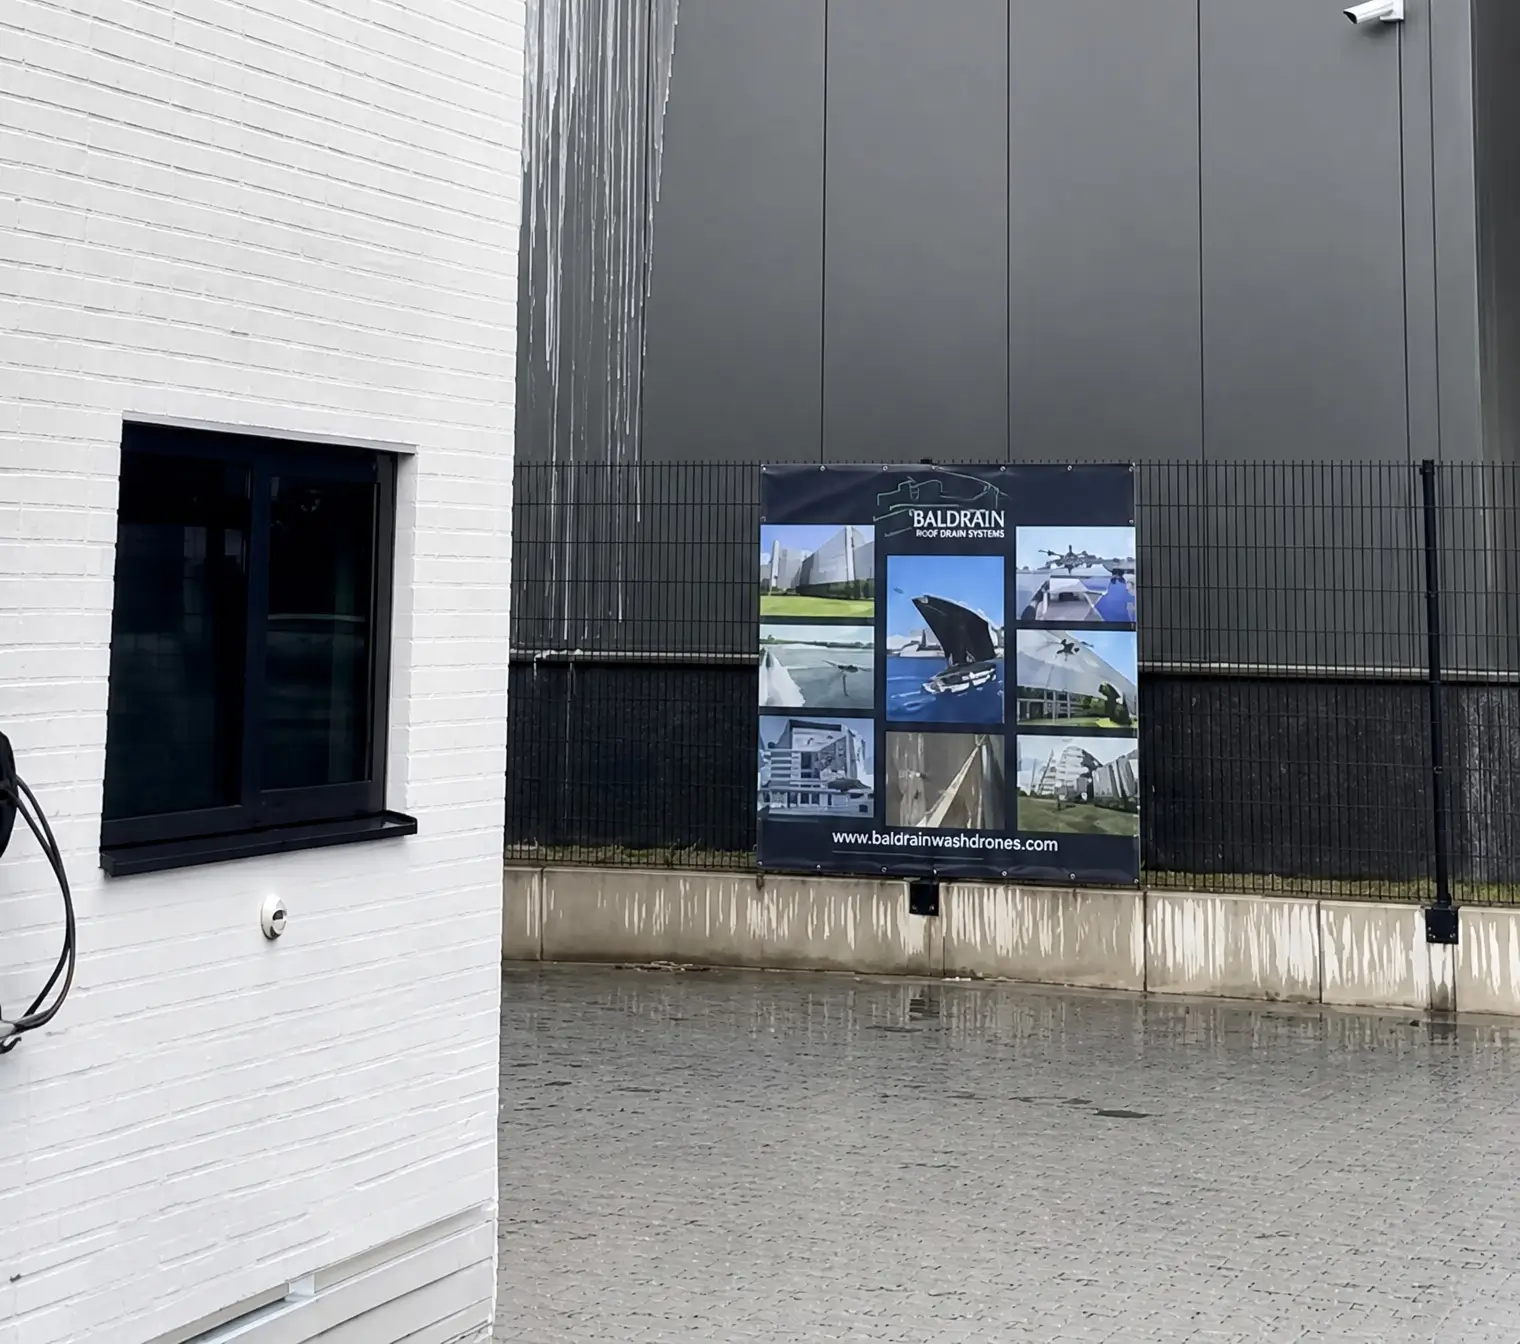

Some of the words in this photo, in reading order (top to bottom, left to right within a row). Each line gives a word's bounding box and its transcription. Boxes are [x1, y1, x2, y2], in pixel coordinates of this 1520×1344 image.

[911, 509, 1005, 528] BALDRAIN
[916, 529, 938, 538] ROOF
[940, 529, 966, 538] DRAIN
[968, 529, 1005, 538] SYSTEMS
[832, 830, 1059, 852] www.baldrainwashdrones.com
